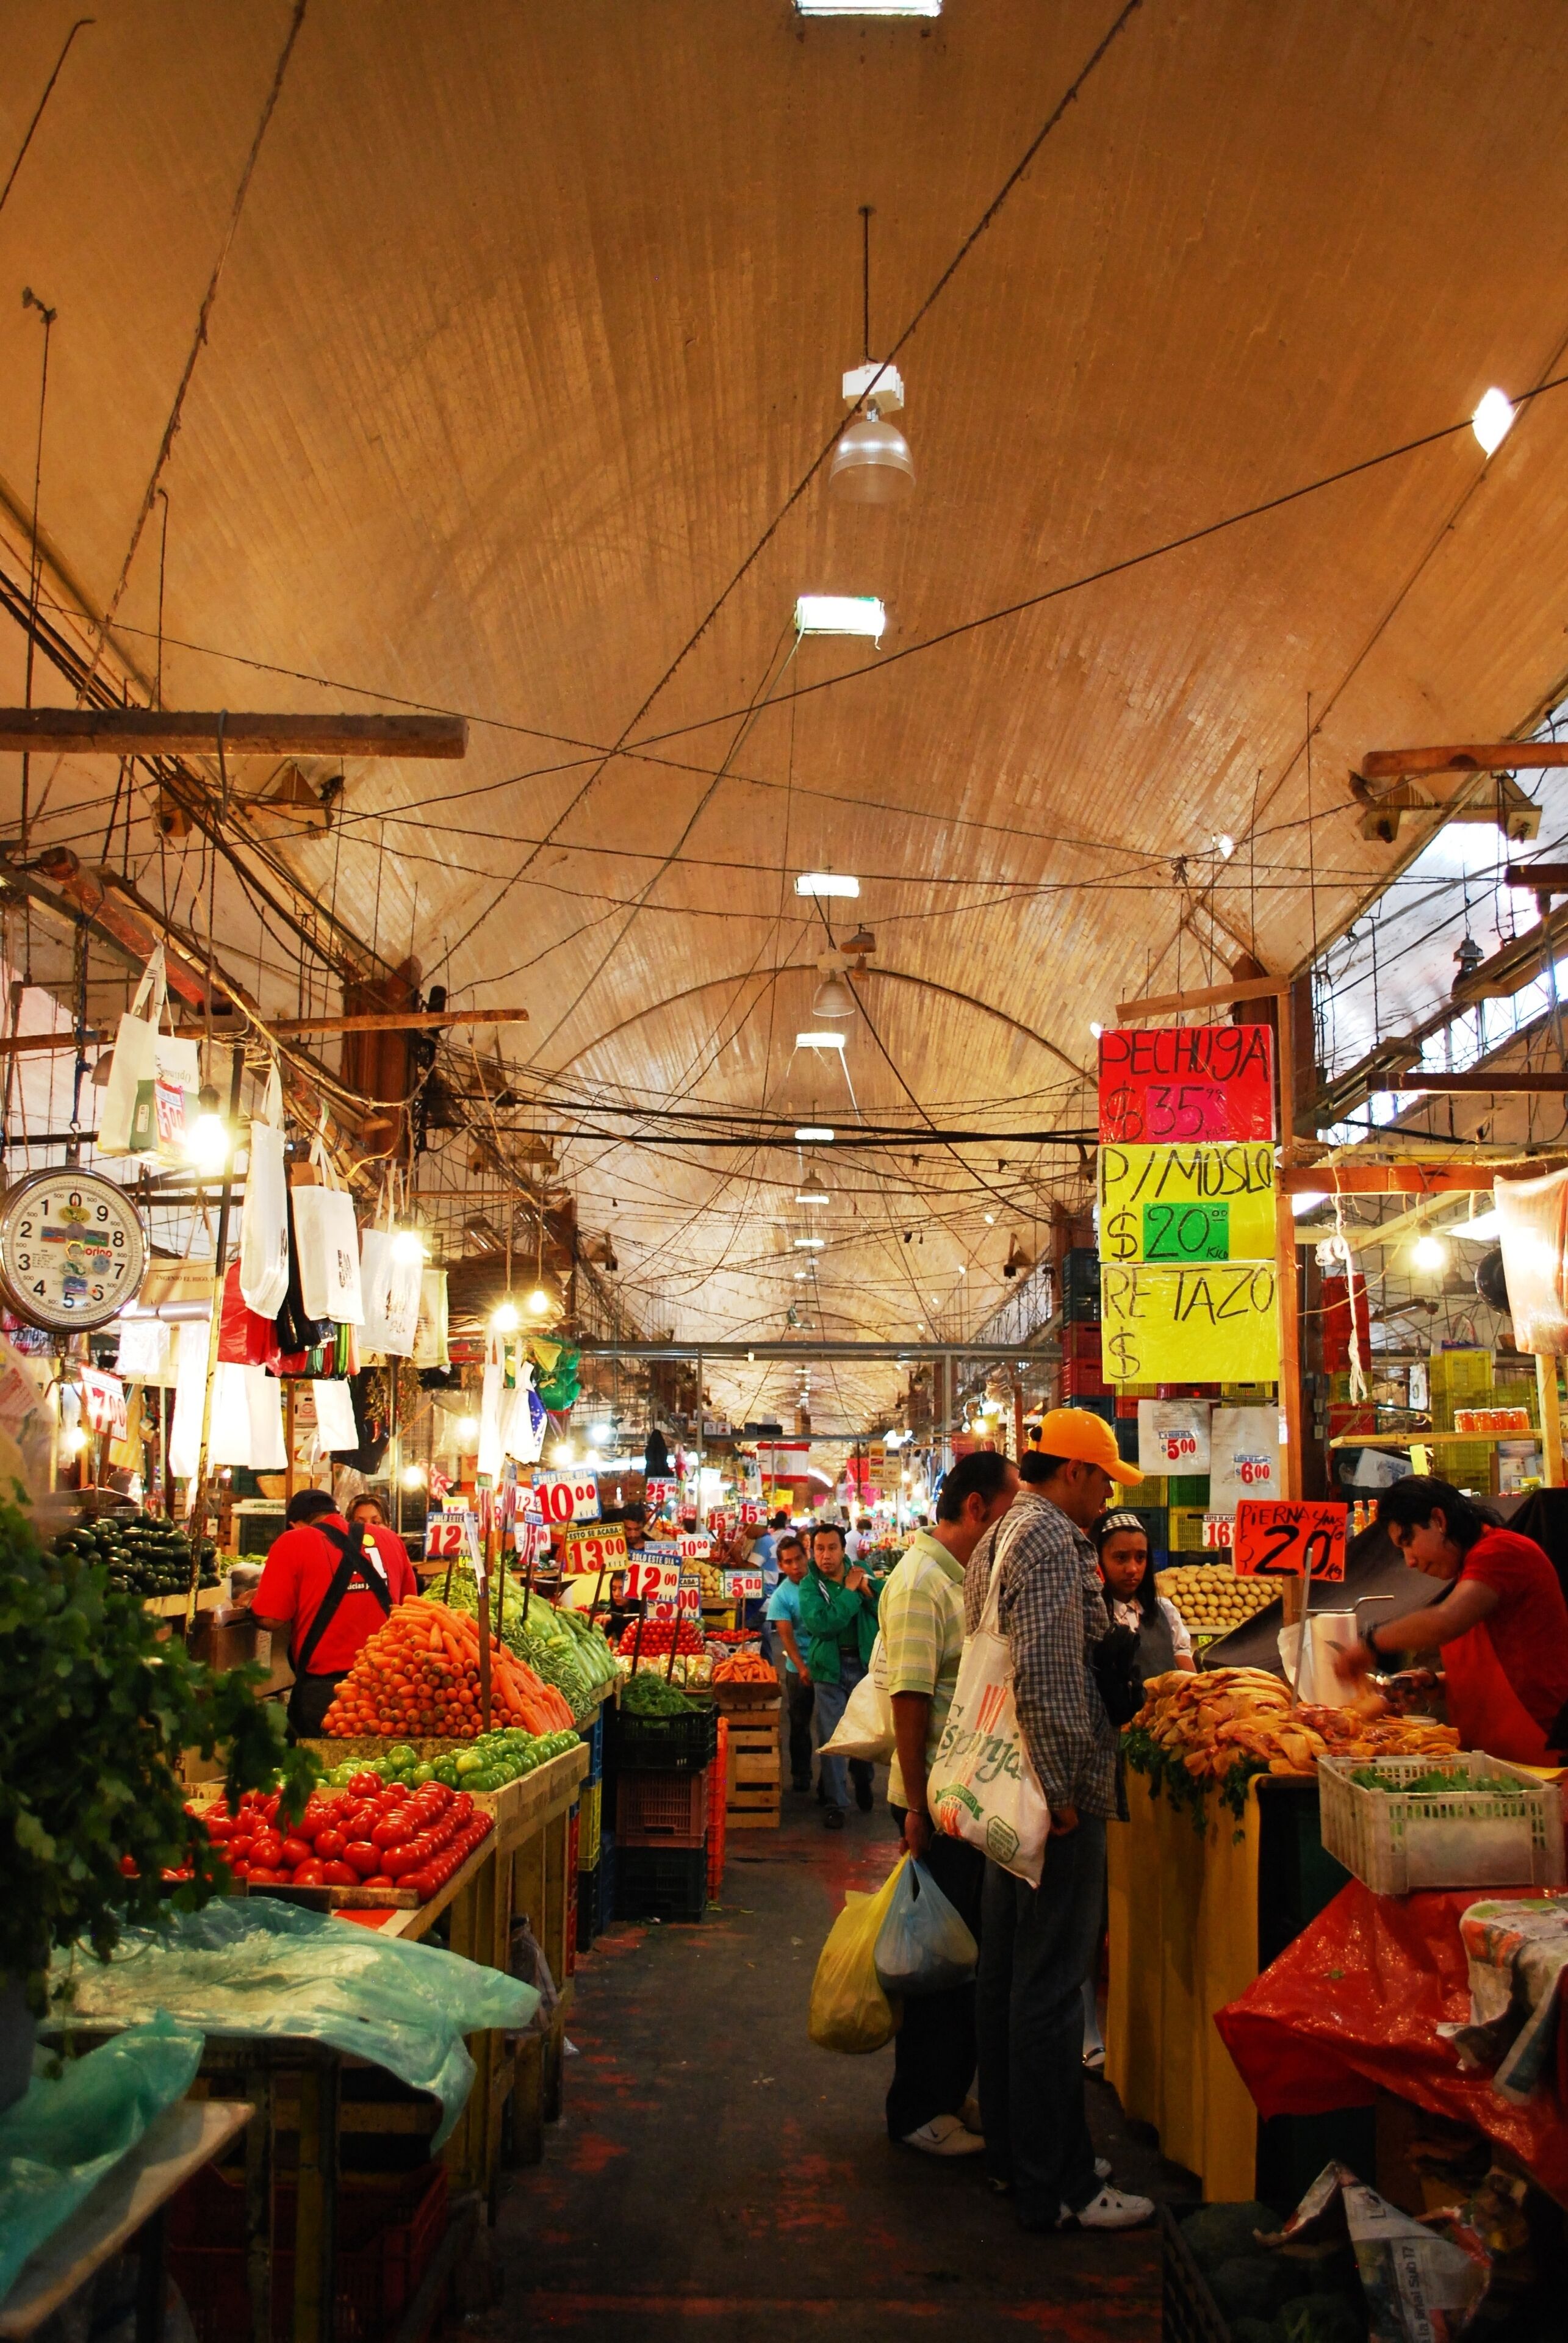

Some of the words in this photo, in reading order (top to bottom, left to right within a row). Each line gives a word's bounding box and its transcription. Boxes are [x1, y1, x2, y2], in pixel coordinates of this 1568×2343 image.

[41, 1199, 49, 1216] 1
[96, 1205, 109, 1222] 9
[20, 1221, 32, 1239] 2
[113, 1231, 124, 1248] 8
[18, 1253, 31, 1271] 3
[114, 1263, 125, 1279] 7
[34, 1279, 46, 1297] 4
[63, 1292, 75, 1309] 5
[1405, 2261, 1420, 2287] Sub
